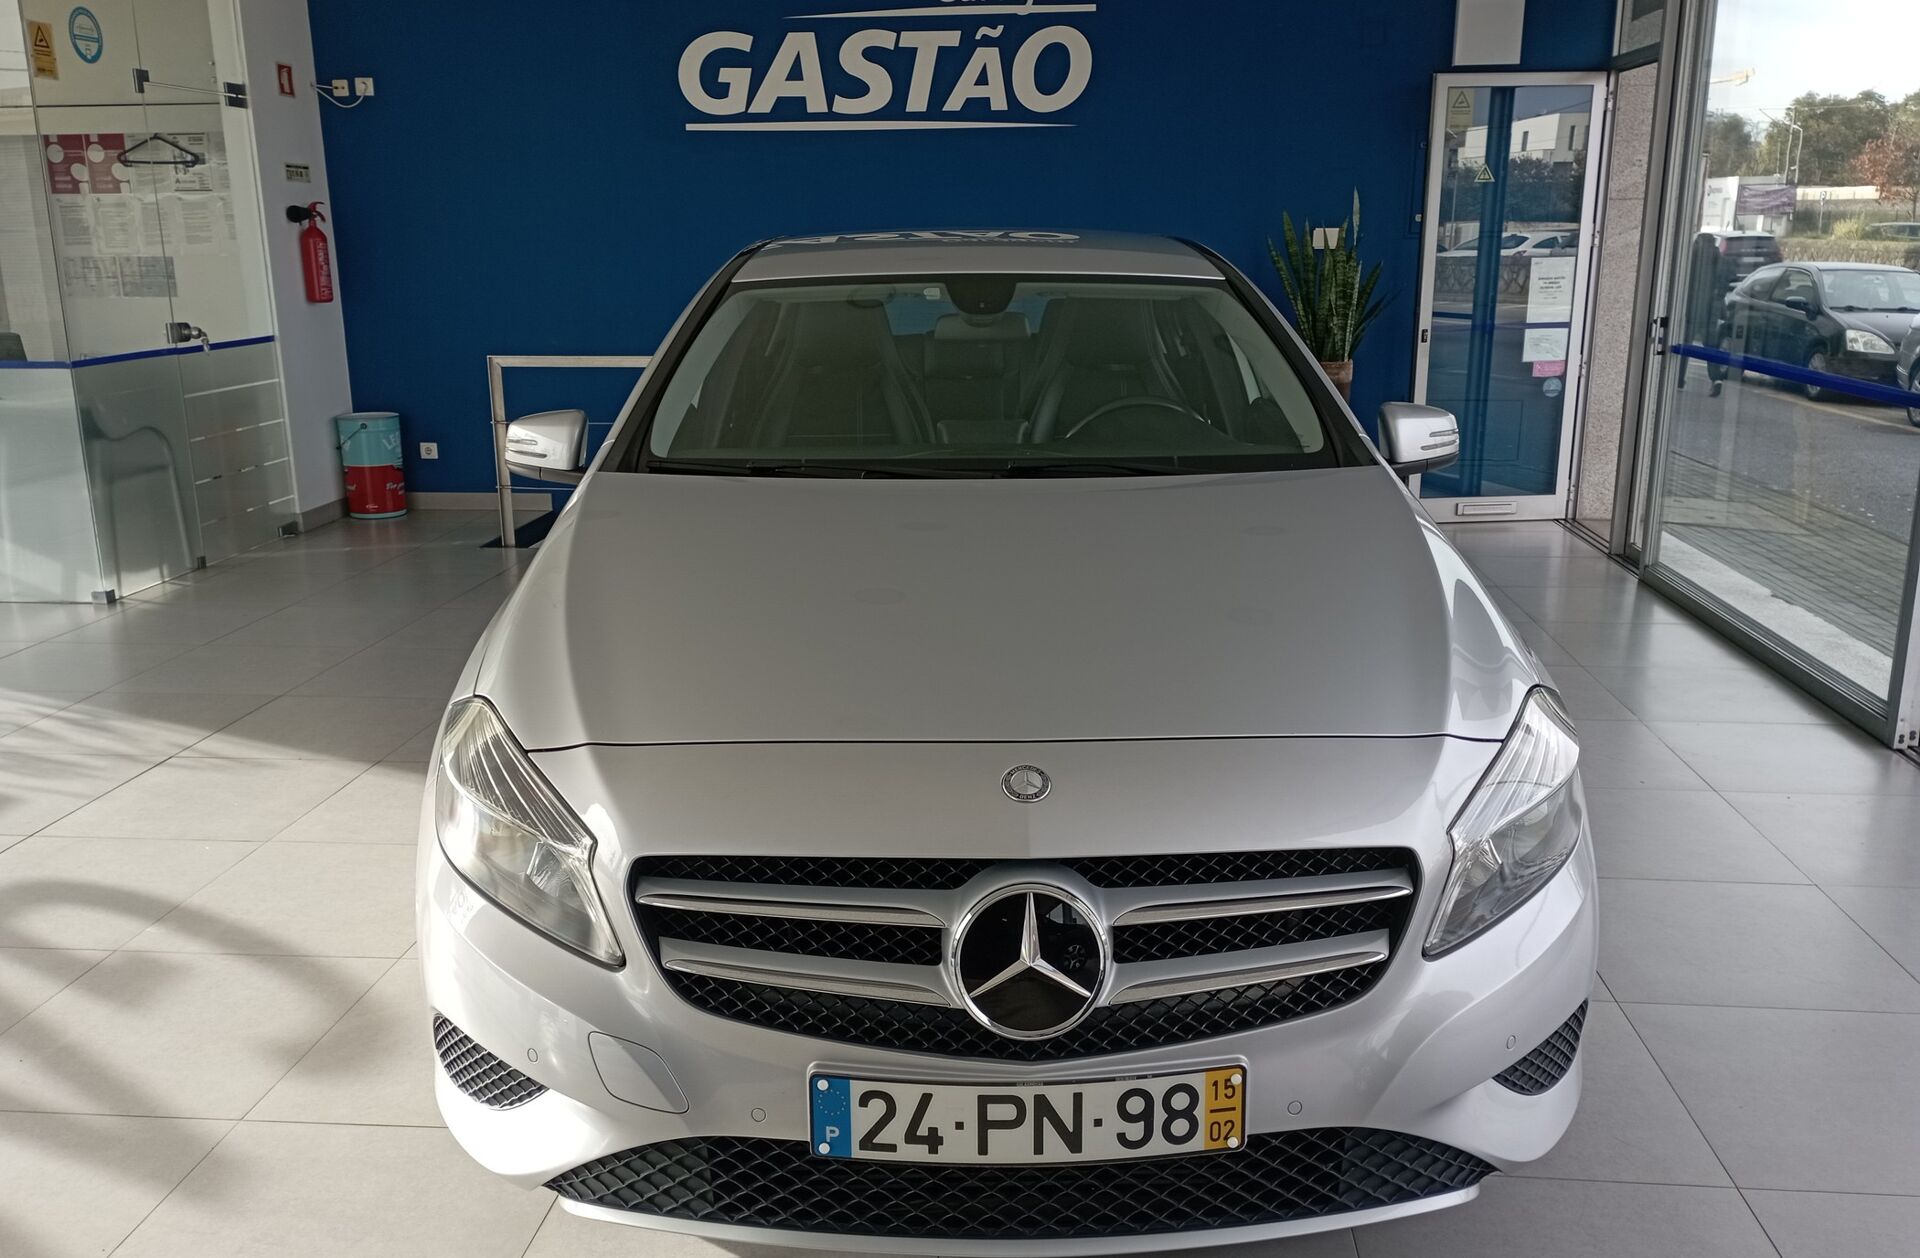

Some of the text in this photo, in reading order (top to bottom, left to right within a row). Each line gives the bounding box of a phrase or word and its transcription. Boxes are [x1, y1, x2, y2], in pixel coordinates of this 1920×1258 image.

[678, 25, 1093, 116] GASTÃO
[1212, 1078, 1236, 1101] 15
[825, 1126, 840, 1142] P
[1210, 1120, 1235, 1142] 02
